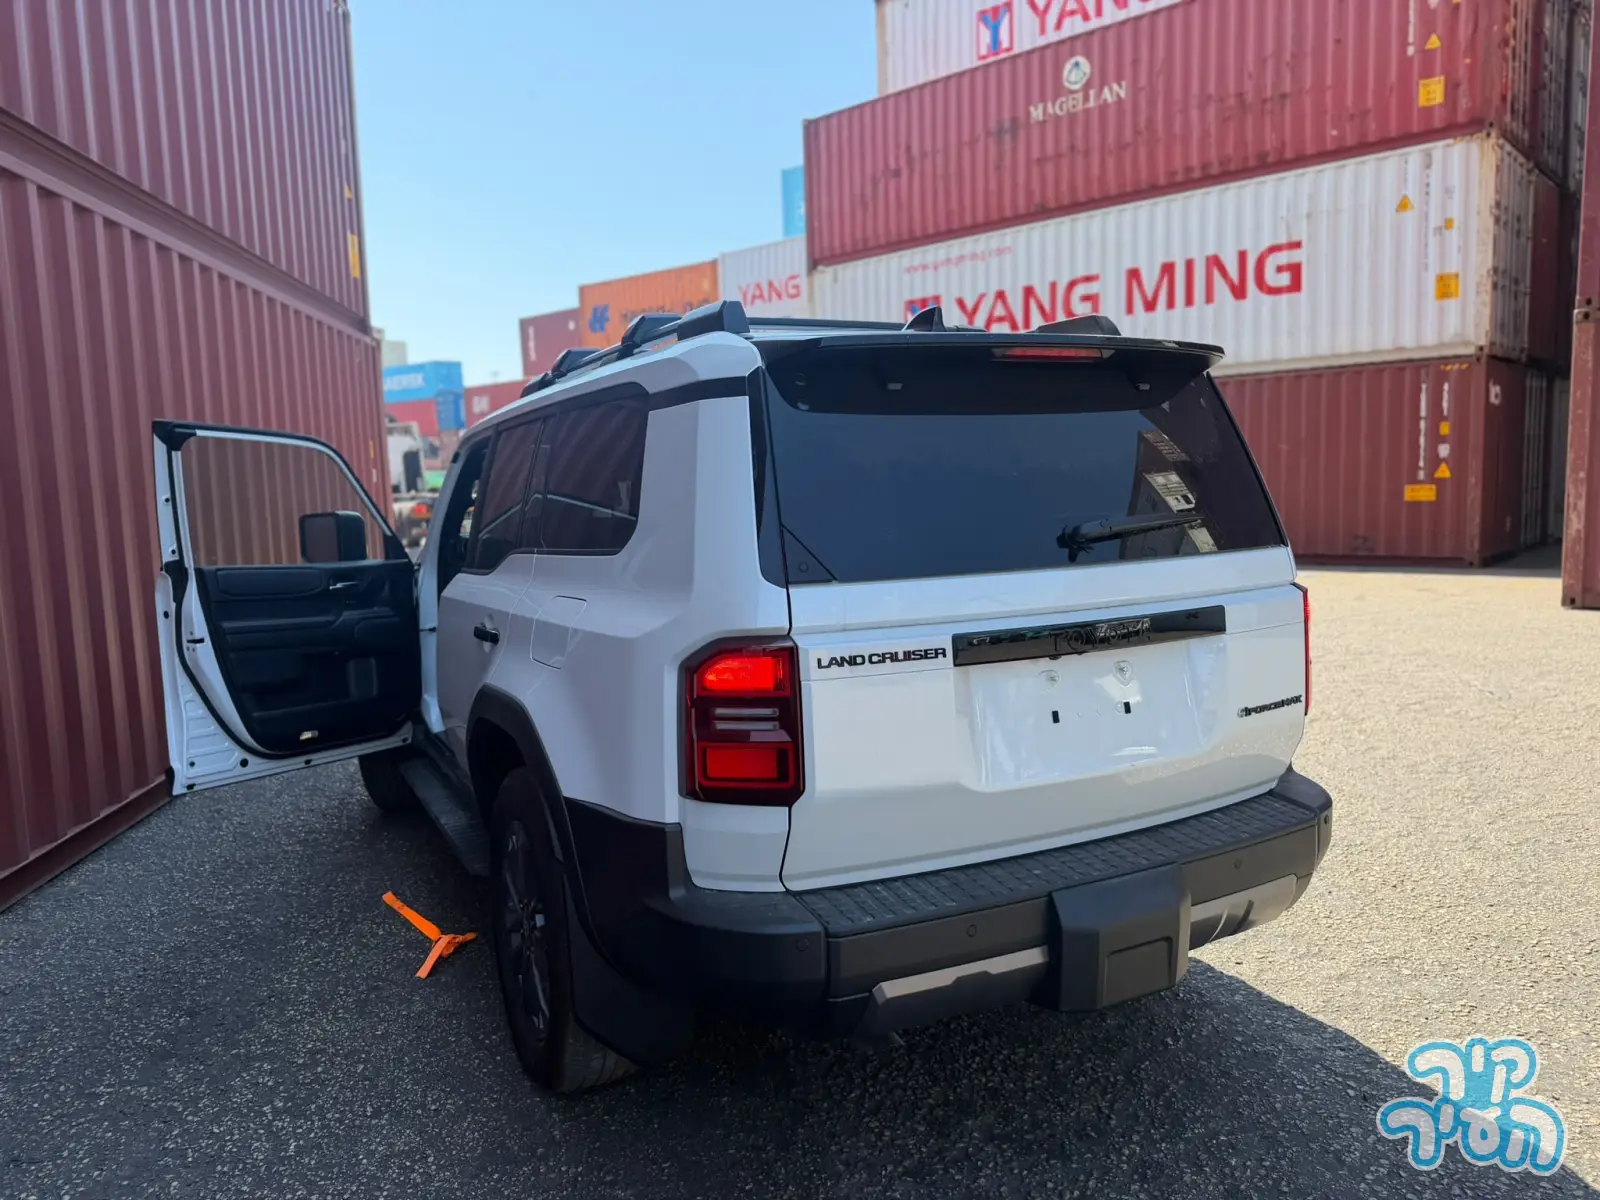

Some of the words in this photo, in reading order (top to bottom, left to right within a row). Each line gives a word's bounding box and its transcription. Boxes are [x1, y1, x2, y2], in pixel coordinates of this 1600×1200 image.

[1030, 81, 1127, 123] MAGELLAN
[738, 274, 802, 308] YANG
[954, 274, 1101, 332] YANG
[1125, 240, 1303, 316] MING
[816, 654, 866, 669] LAND
[868, 647, 947, 665] CRUISER
